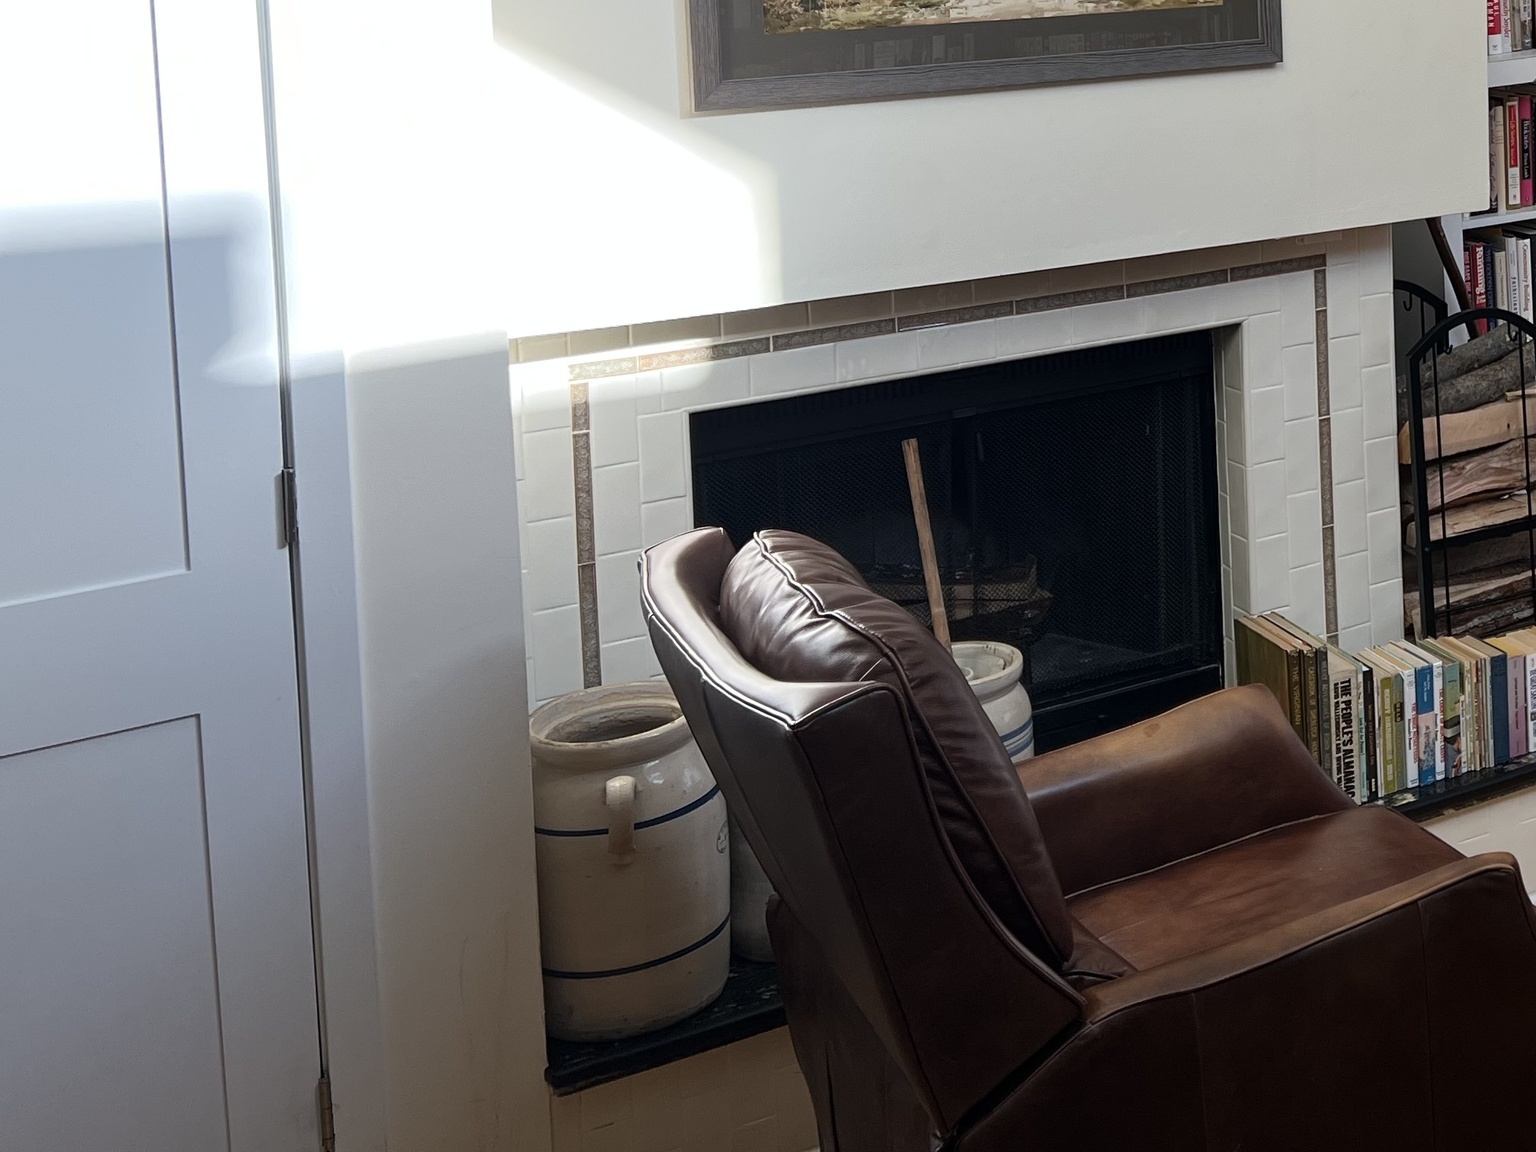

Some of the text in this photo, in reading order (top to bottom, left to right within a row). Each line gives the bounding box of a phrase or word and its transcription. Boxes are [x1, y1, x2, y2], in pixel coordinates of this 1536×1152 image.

[1475, 246, 1486, 294] Running
[1291, 666, 1301, 726] THE VIRGINIAN
[1321, 683, 1329, 720] ADVENTURES
[1322, 732, 1330, 751] ROBIN
[1340, 678, 1356, 798] THE PEOPLE'S ALMANAC
[1323, 752, 1331, 769] HOOD
